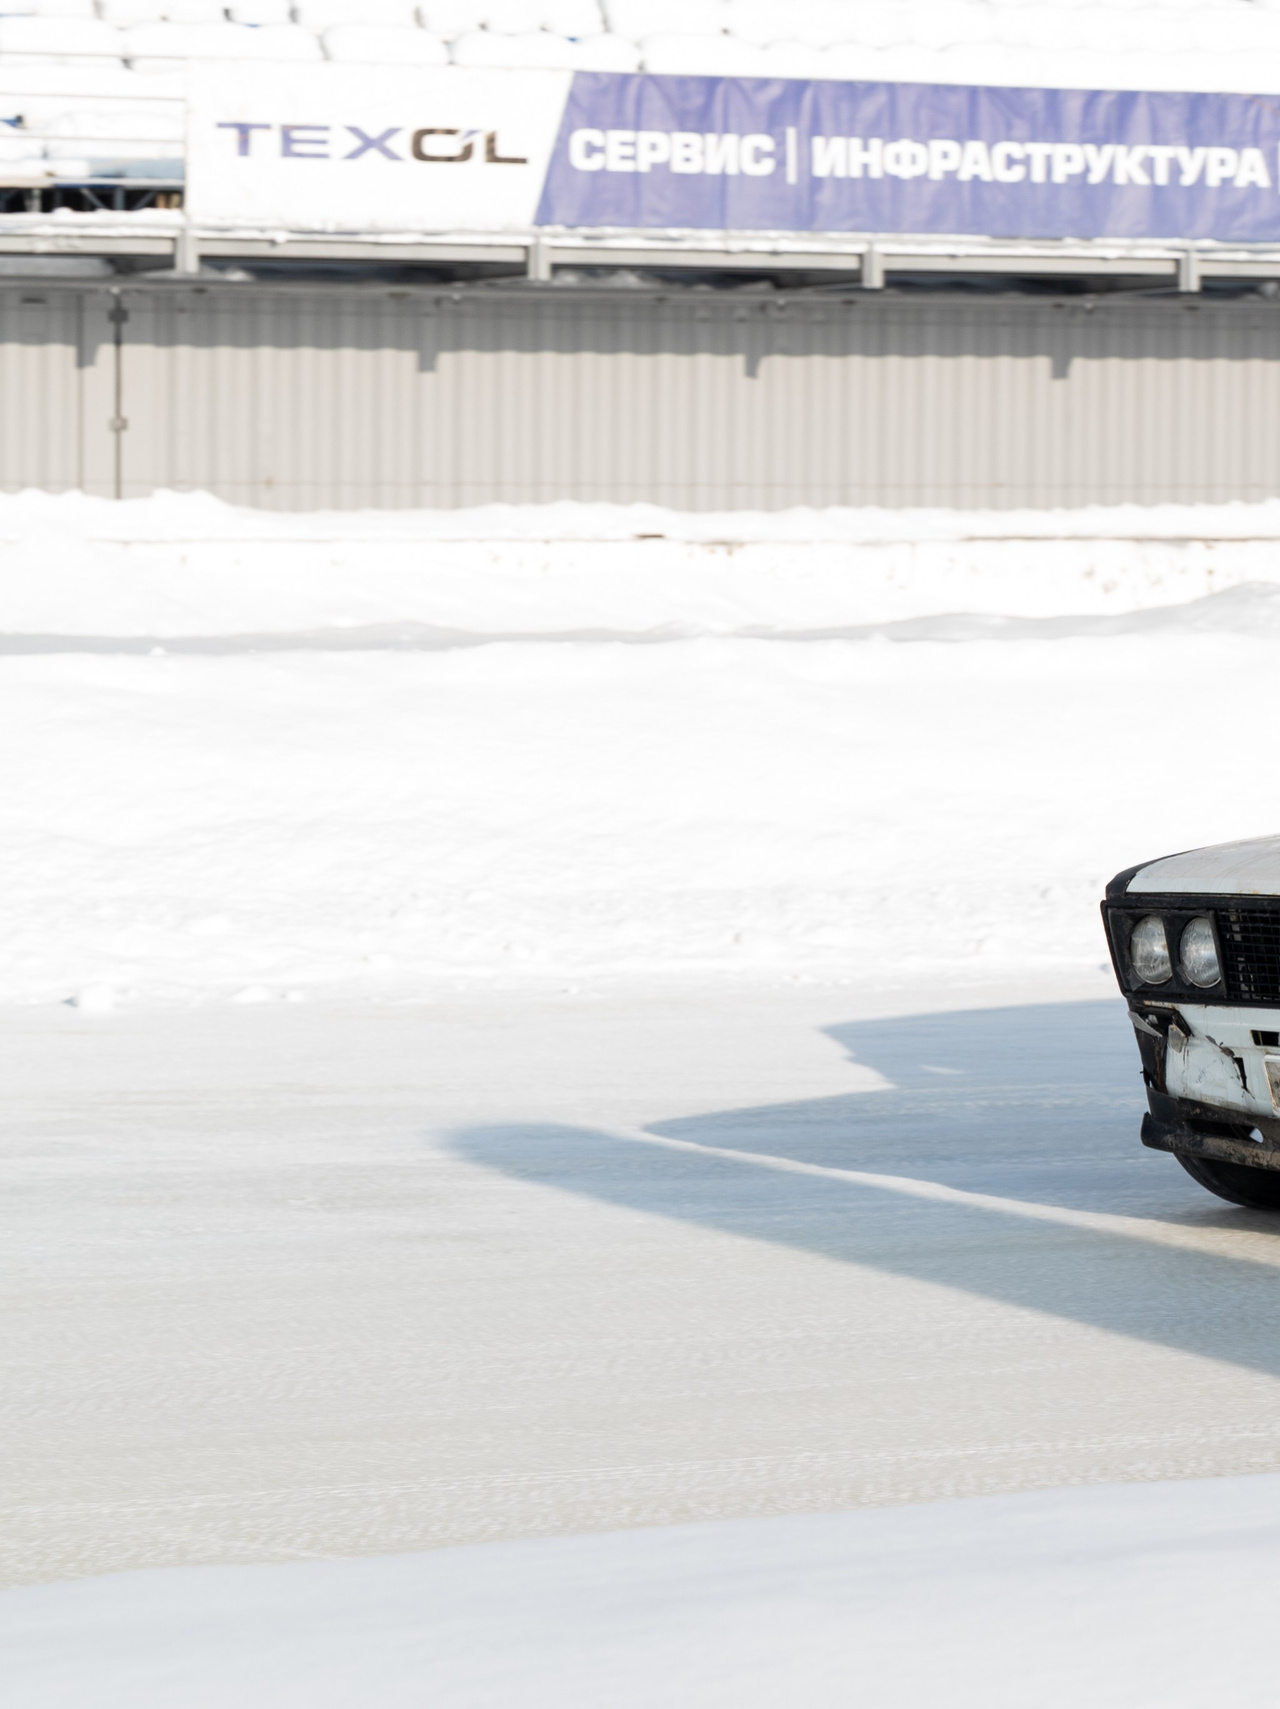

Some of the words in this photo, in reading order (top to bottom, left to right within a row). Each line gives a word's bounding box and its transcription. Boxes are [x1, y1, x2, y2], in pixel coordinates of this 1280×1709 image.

[215, 121, 528, 164] TEXOL
[567, 127, 775, 176] СЕРВИС
[811, 134, 1272, 188] ИНФРАСТРУКТУРА
